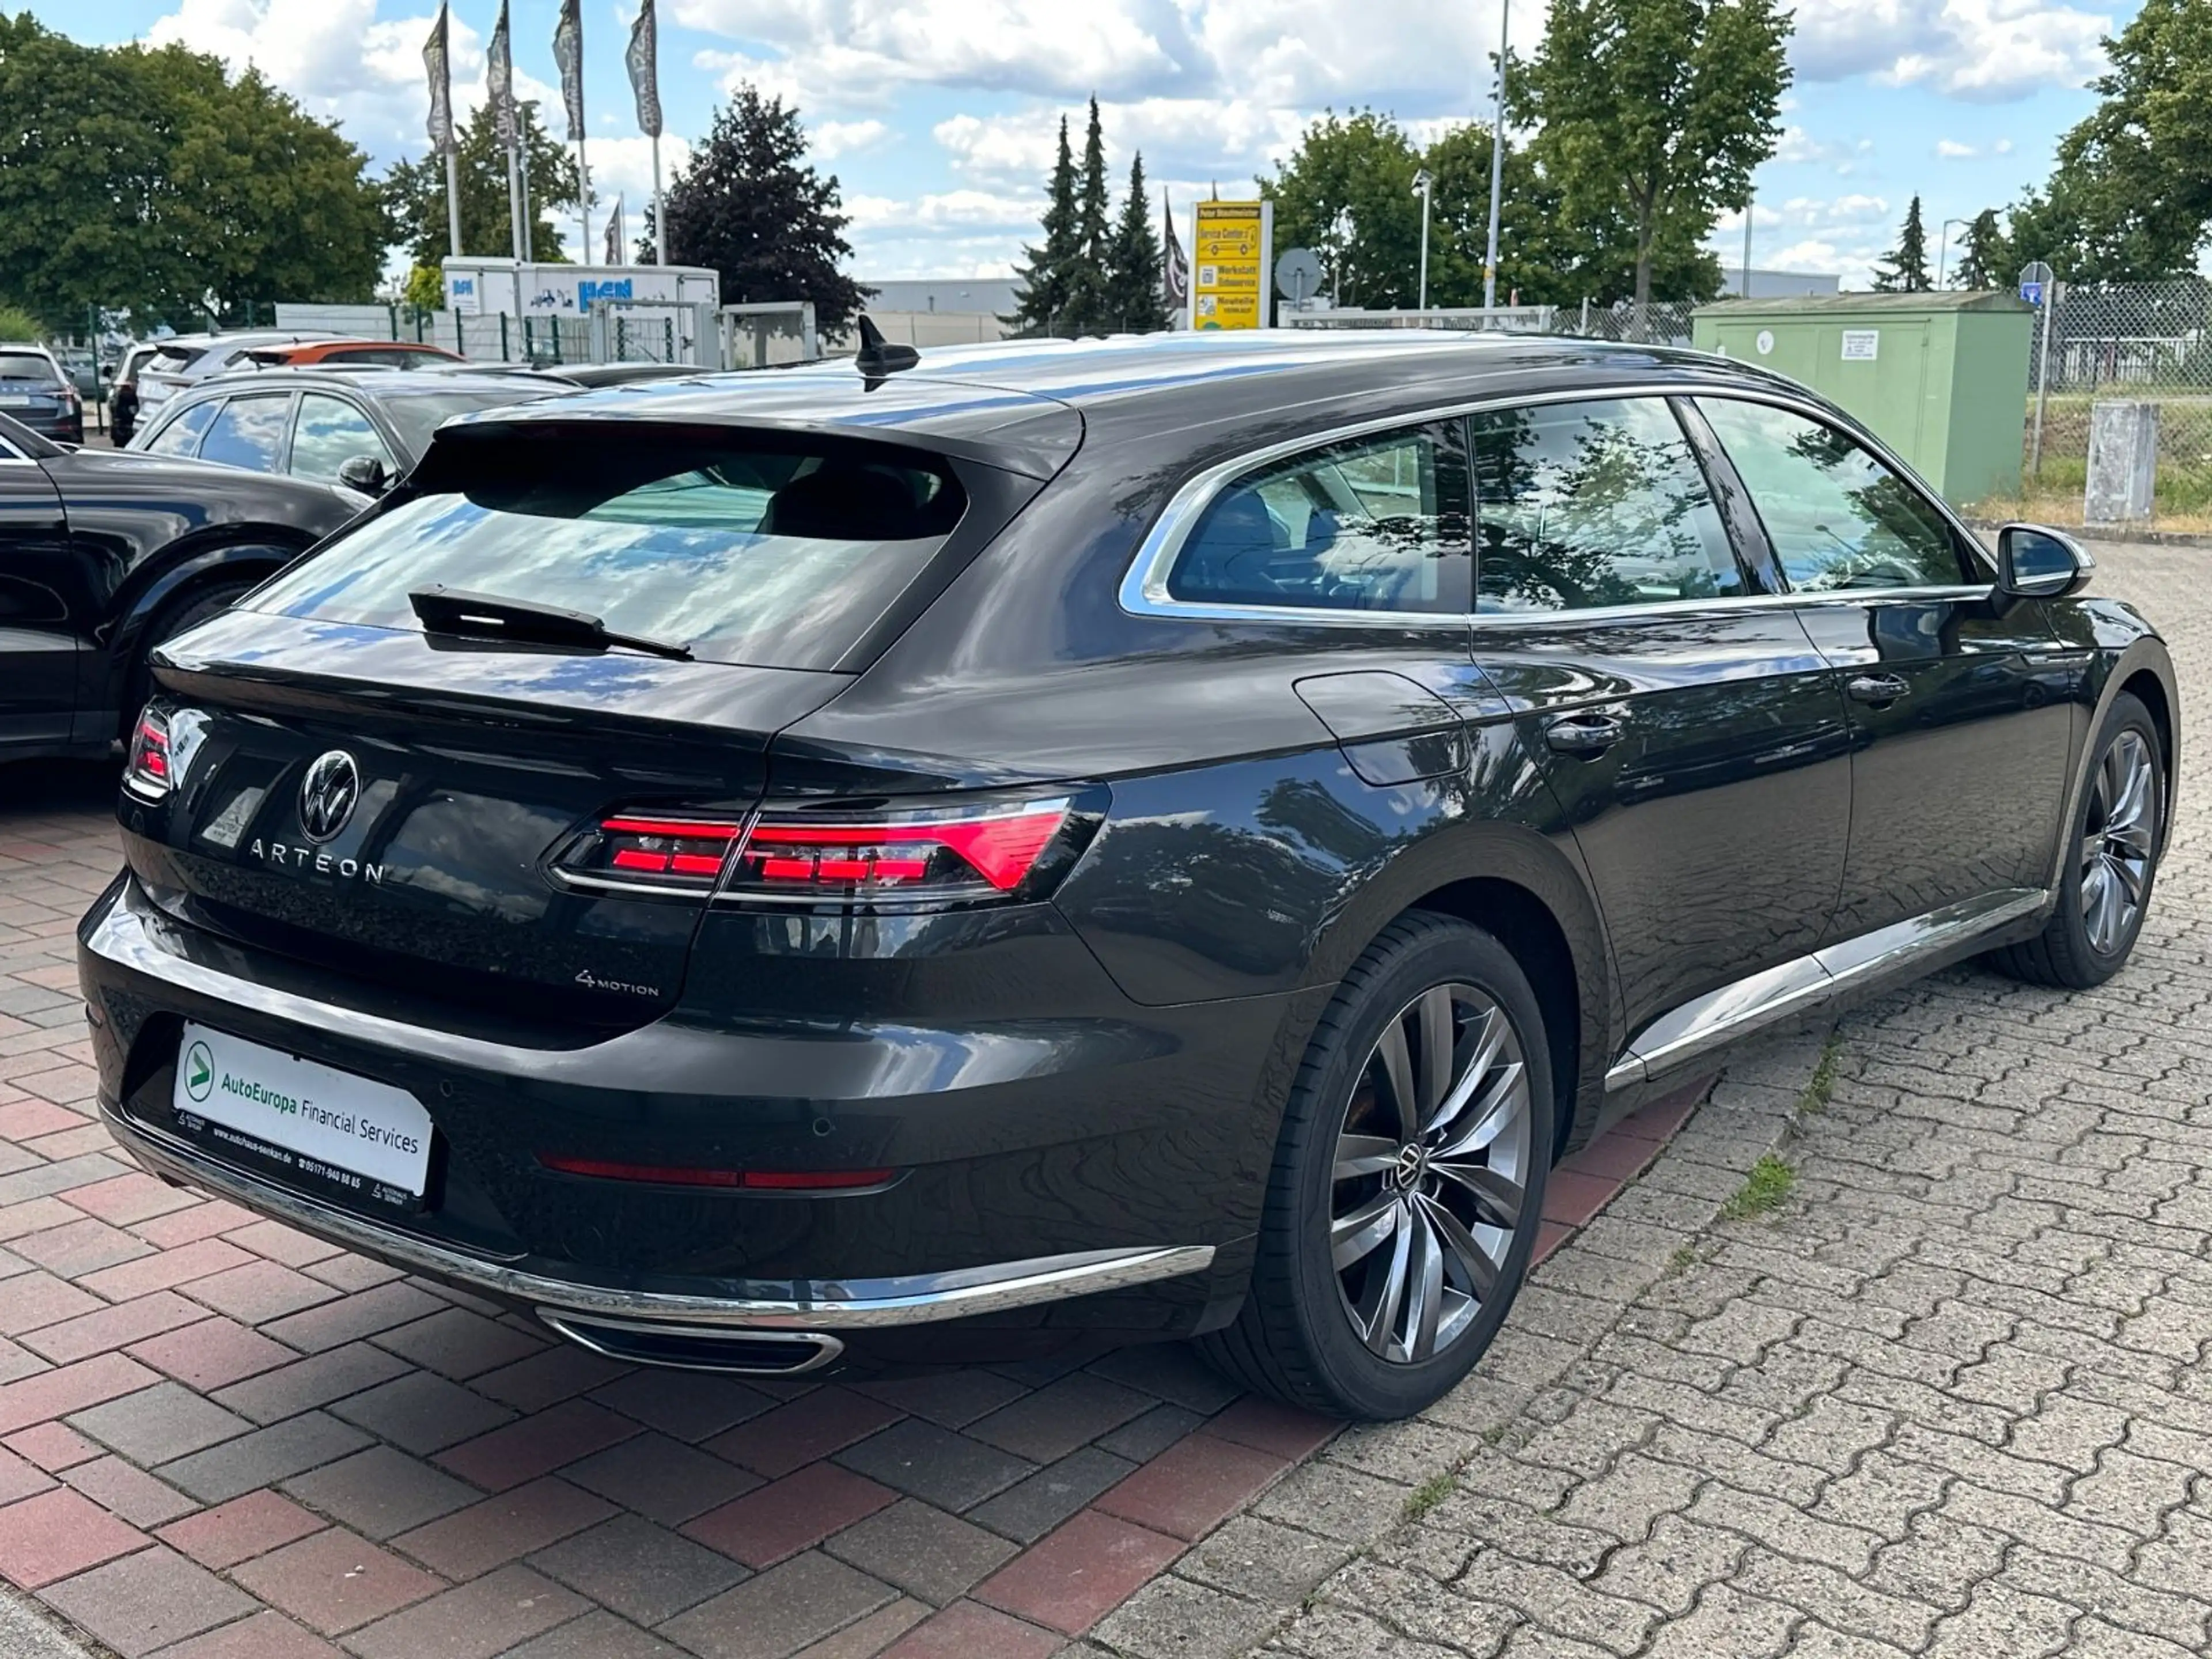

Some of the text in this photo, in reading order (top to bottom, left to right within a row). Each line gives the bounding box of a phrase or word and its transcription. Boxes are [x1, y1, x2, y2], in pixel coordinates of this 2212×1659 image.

[250, 839, 384, 884] ARTEON
[222, 1073, 418, 1154] AutoEuropa Financial Services
